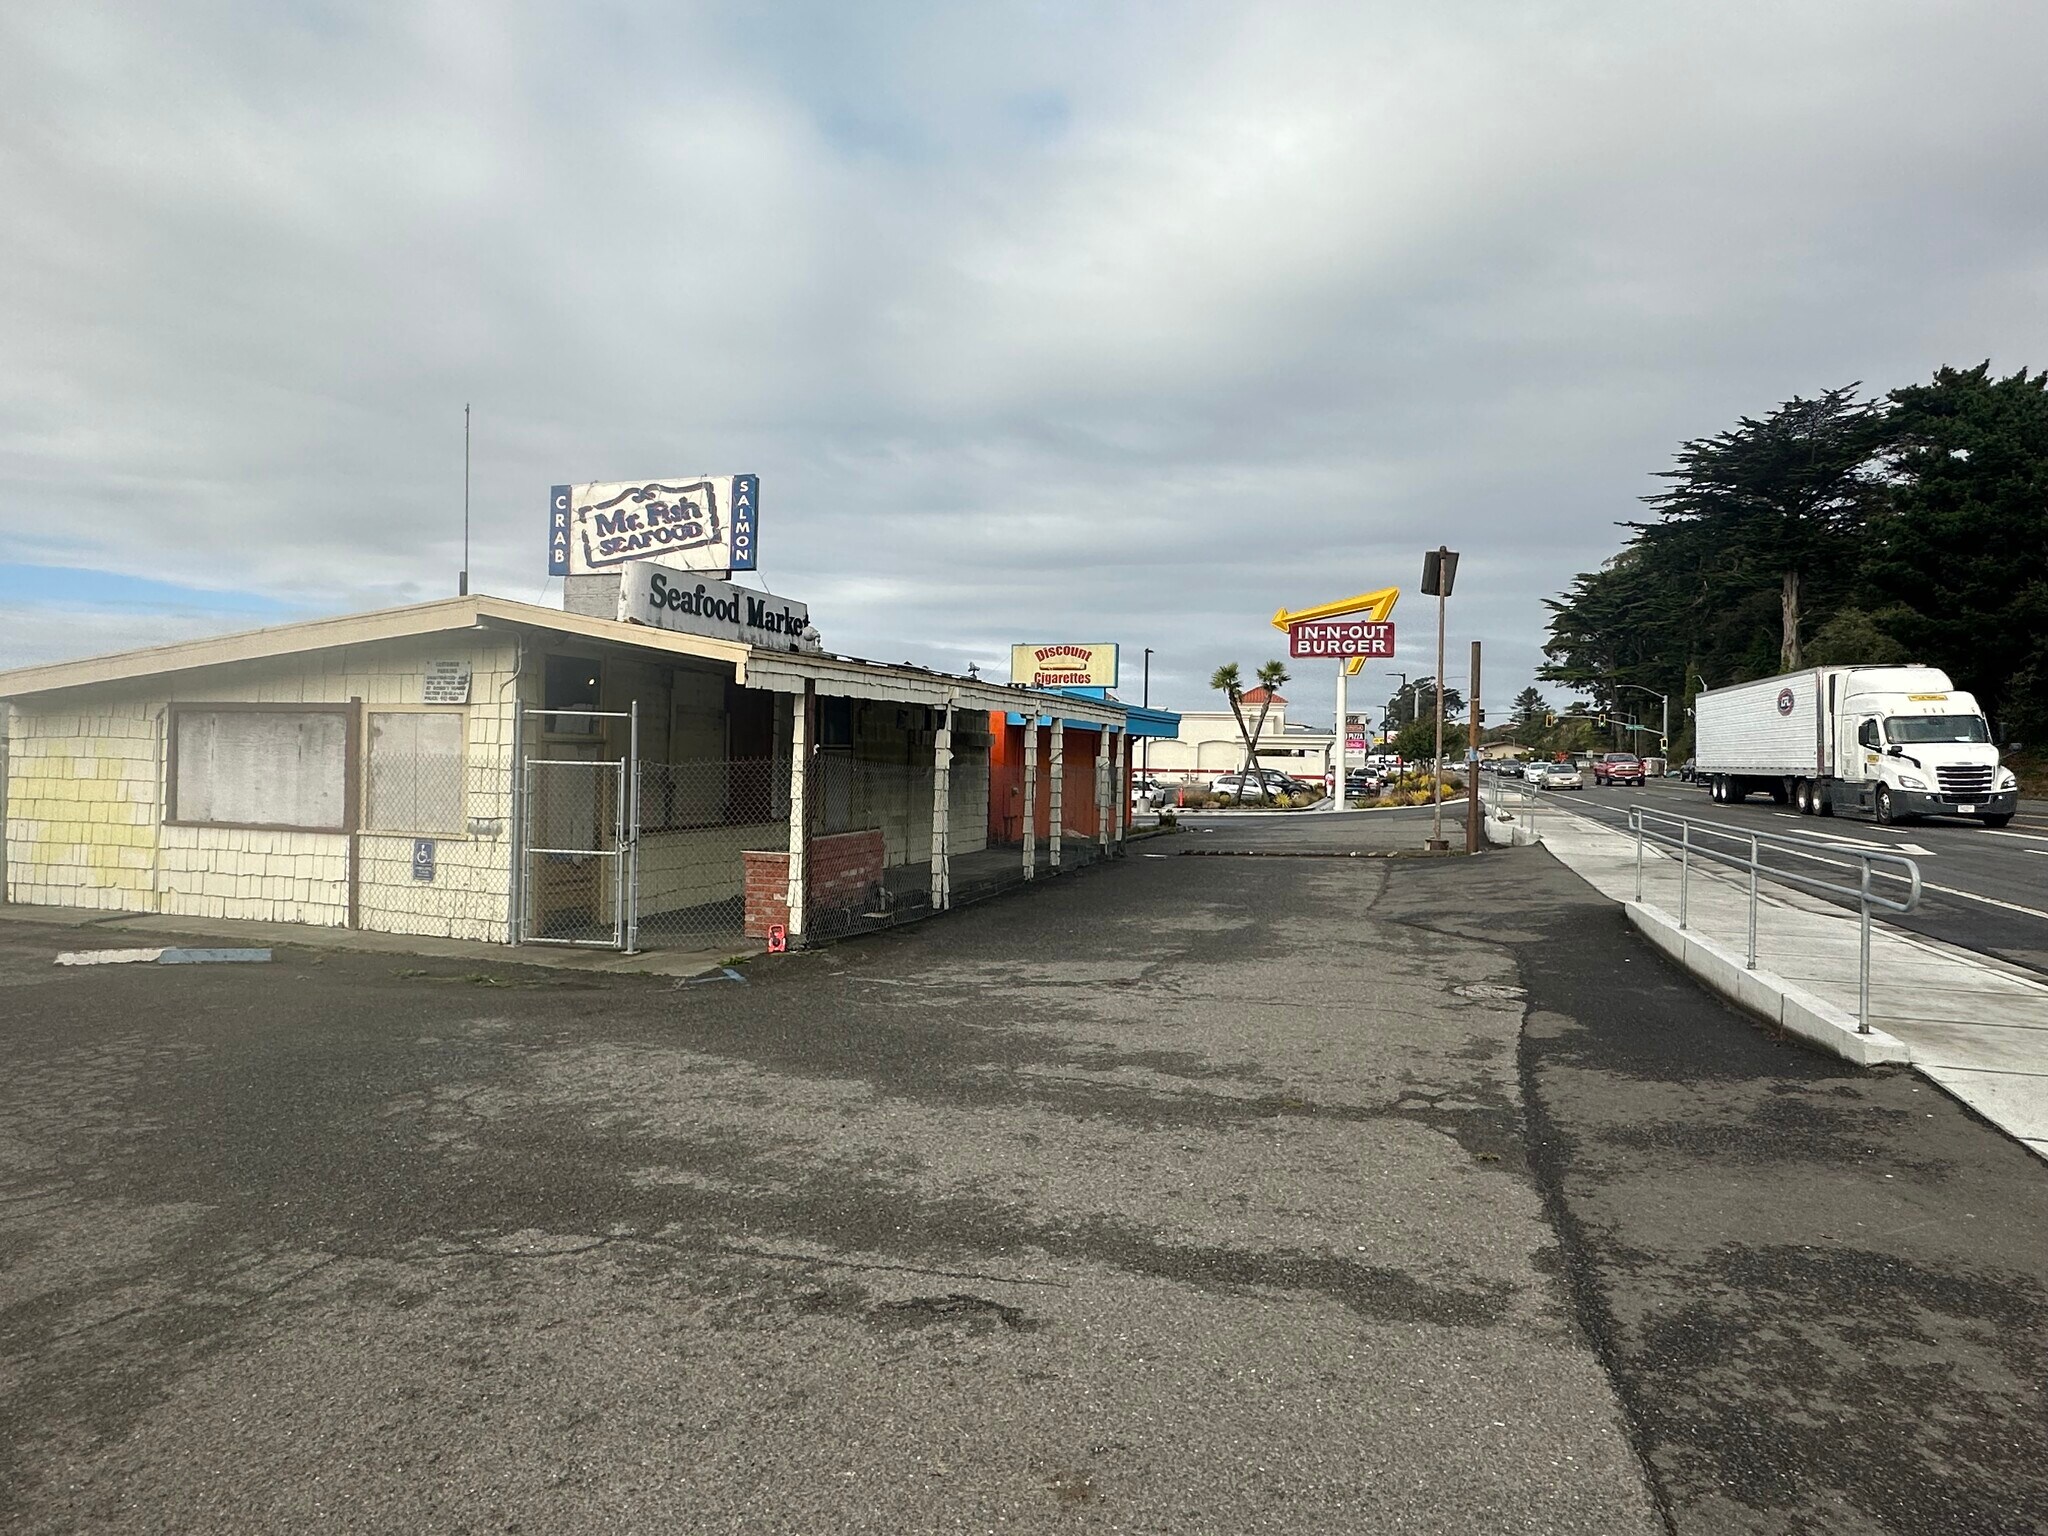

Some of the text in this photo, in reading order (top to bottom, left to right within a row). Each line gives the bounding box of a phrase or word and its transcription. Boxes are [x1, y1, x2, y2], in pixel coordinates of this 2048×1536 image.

[553, 495, 567, 563] CRAB
[595, 497, 703, 537] Mr. Fish
[735, 481, 750, 561] SALMON
[600, 522, 703, 556] SEAFOOD
[650, 573, 740, 624] Seafood
[1297, 640, 1386, 653] BURGER
[1298, 625, 1389, 639] IN-N-OUT
[1034, 646, 1092, 662] Discount
[1034, 672, 1091, 685] Cigarettes
